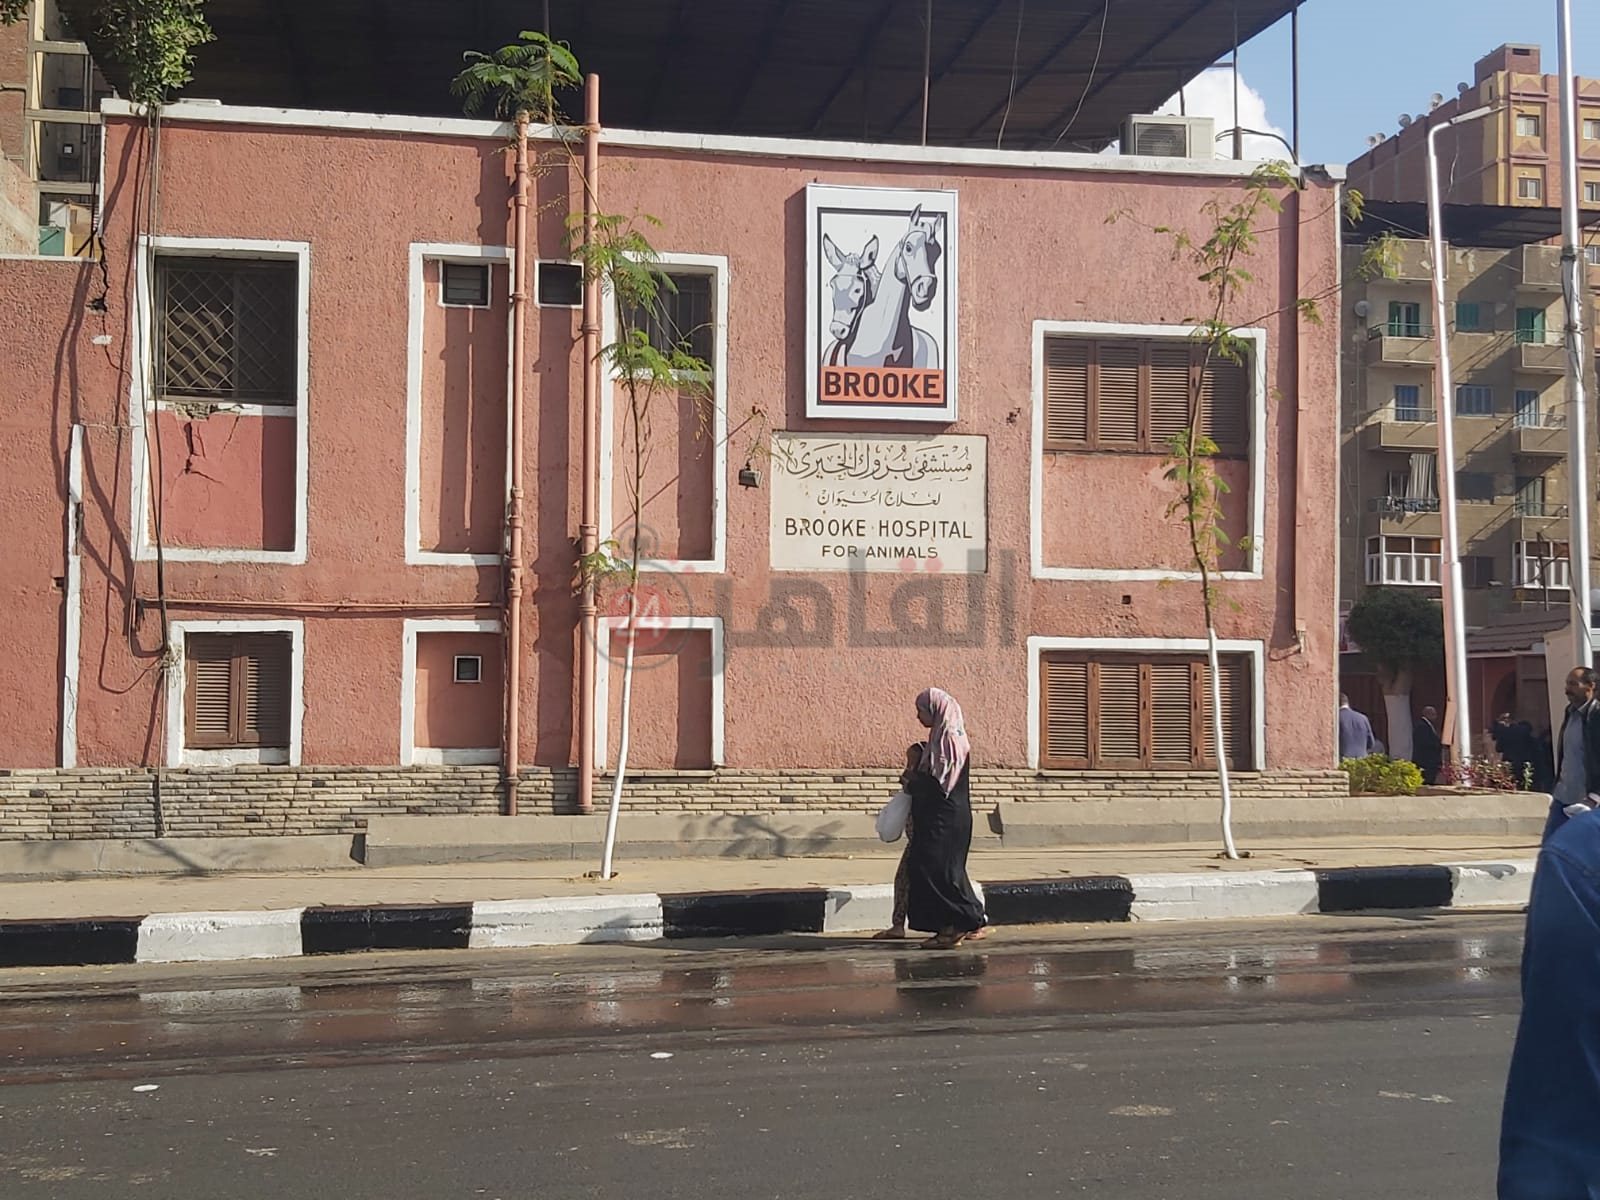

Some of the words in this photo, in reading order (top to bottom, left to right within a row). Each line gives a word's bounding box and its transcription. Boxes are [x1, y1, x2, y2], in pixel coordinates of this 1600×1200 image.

[824, 371, 941, 399] BROOKE
[817, 488, 882, 508] الحيوان
[884, 488, 942, 508] لعلاج
[785, 517, 867, 538] BROOKE
[878, 519, 974, 539] HOSPITAL
[821, 544, 859, 558] FOR
[865, 545, 939, 560] ANIMALS
